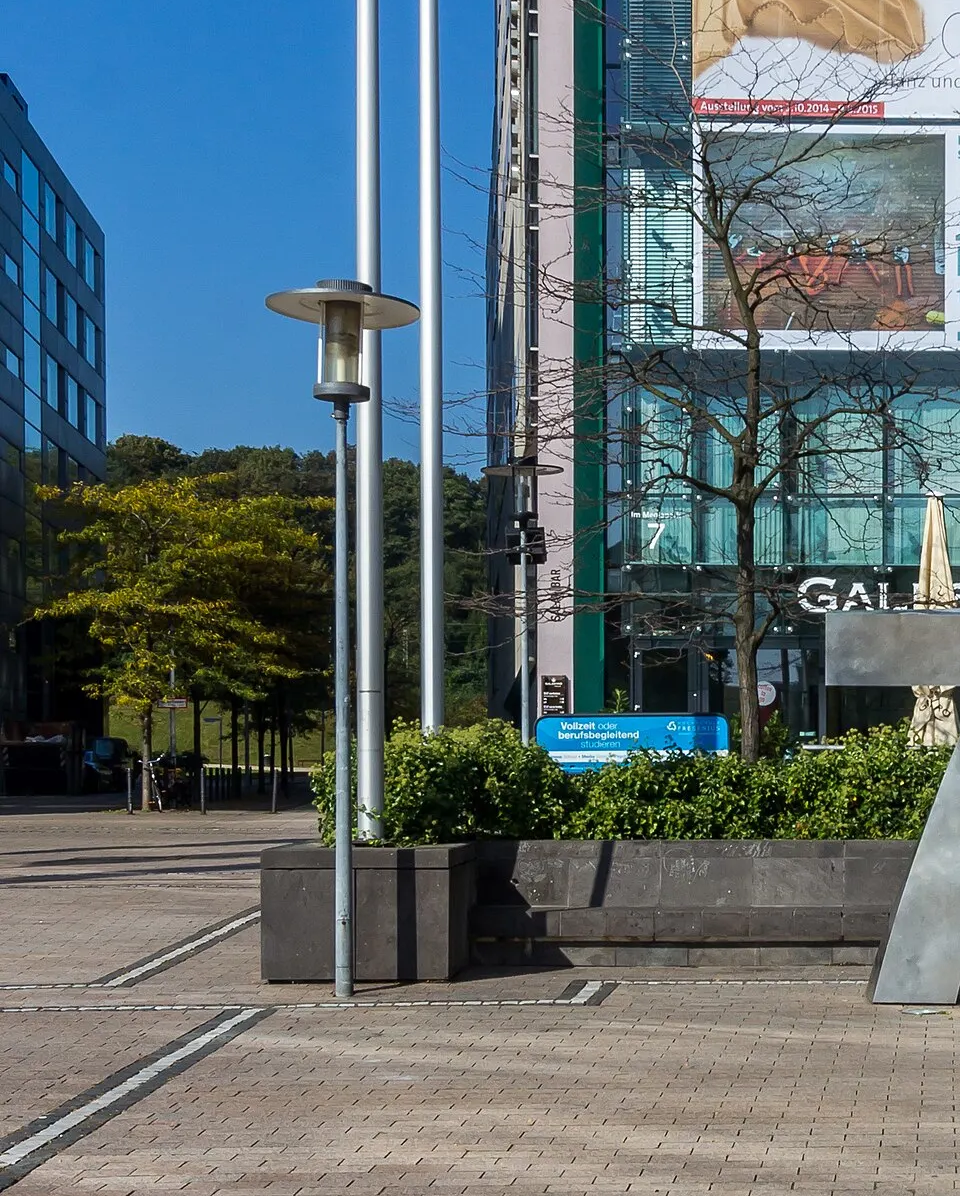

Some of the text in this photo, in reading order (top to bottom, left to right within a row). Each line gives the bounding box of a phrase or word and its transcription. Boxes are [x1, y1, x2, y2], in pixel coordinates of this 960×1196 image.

[647, 522, 666, 550] 7
[550, 569, 561, 588] BAR
[560, 721, 618, 731] Vollzeit oder
[557, 730, 640, 741] berufsbegleitend
[580, 739, 621, 749] studieren
